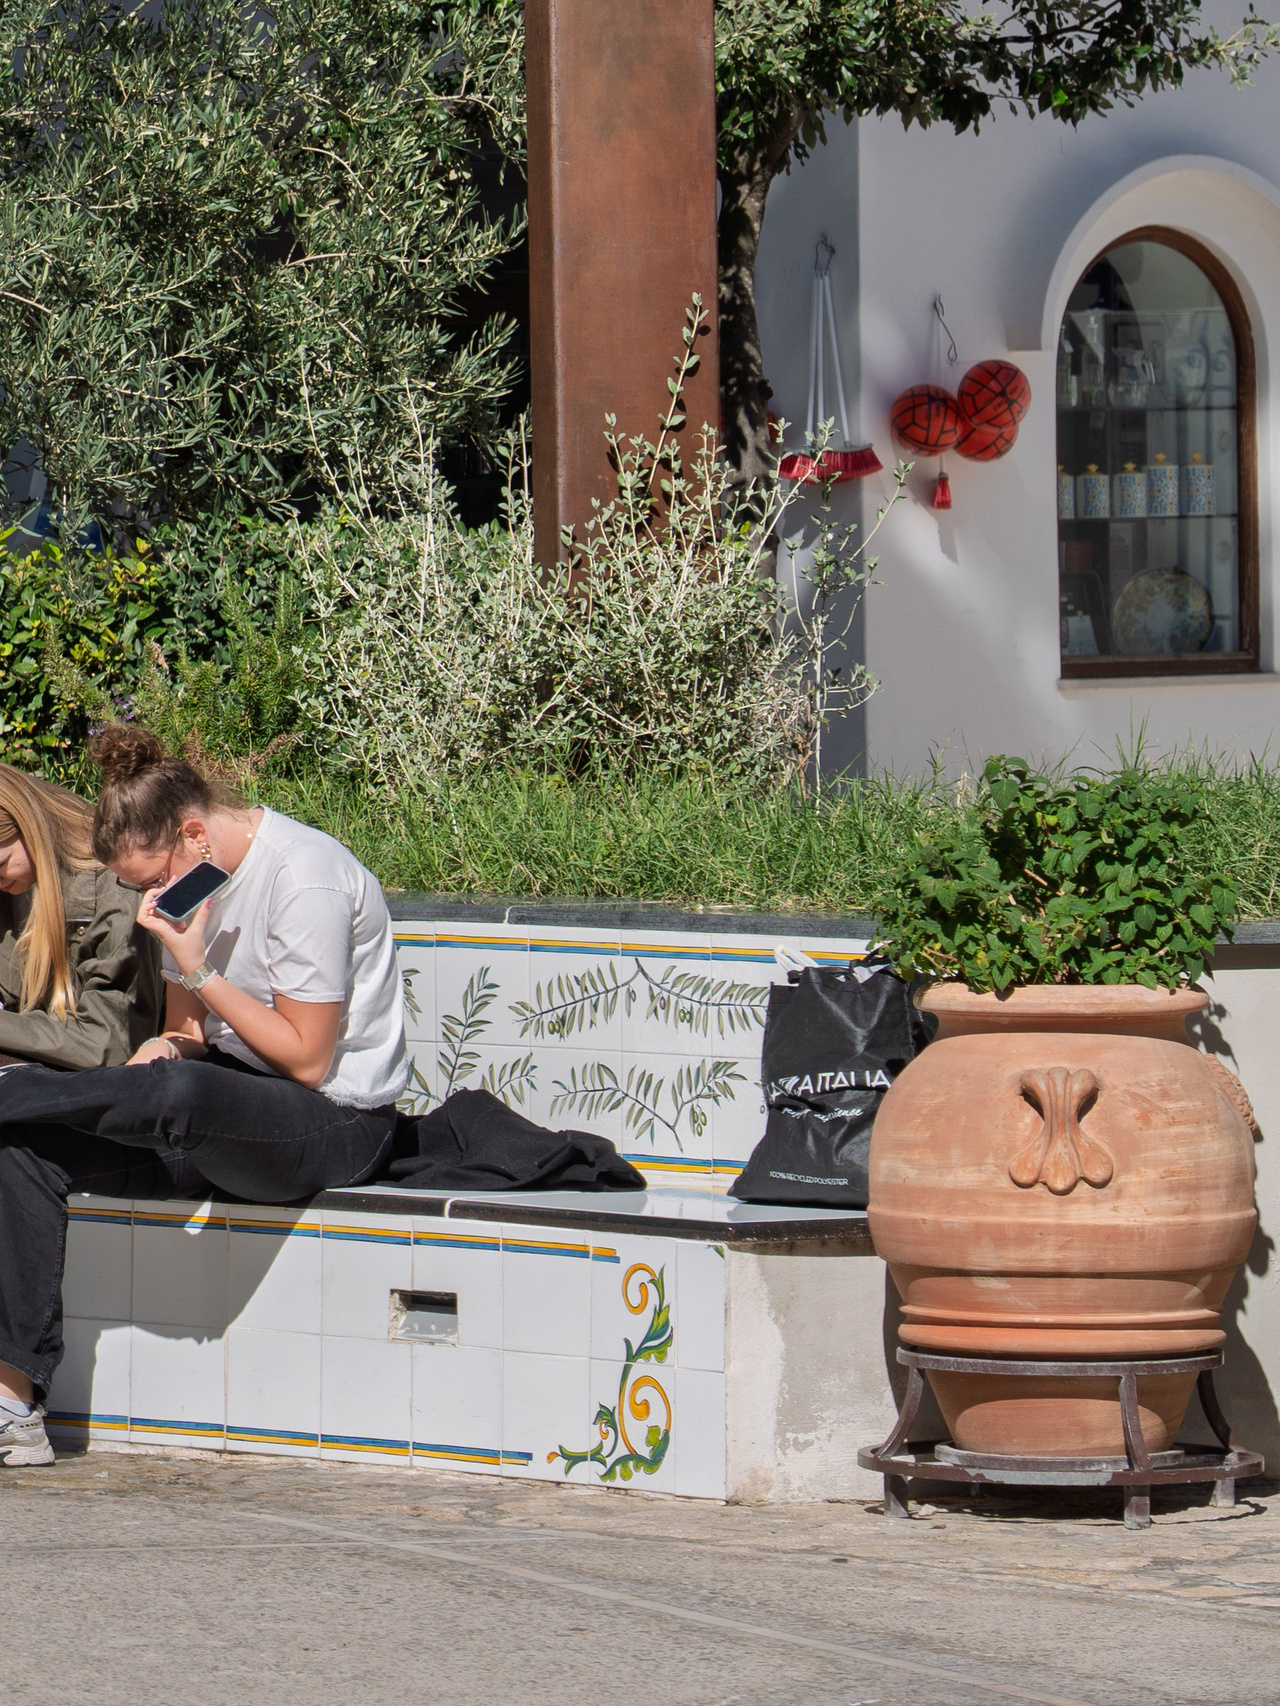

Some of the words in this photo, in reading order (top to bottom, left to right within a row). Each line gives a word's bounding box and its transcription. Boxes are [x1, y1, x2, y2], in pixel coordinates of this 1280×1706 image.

[769, 1170, 787, 1180] 100%
[786, 1173, 814, 1184] RECYCLED
[814, 1176, 849, 1186] POLYESTER
